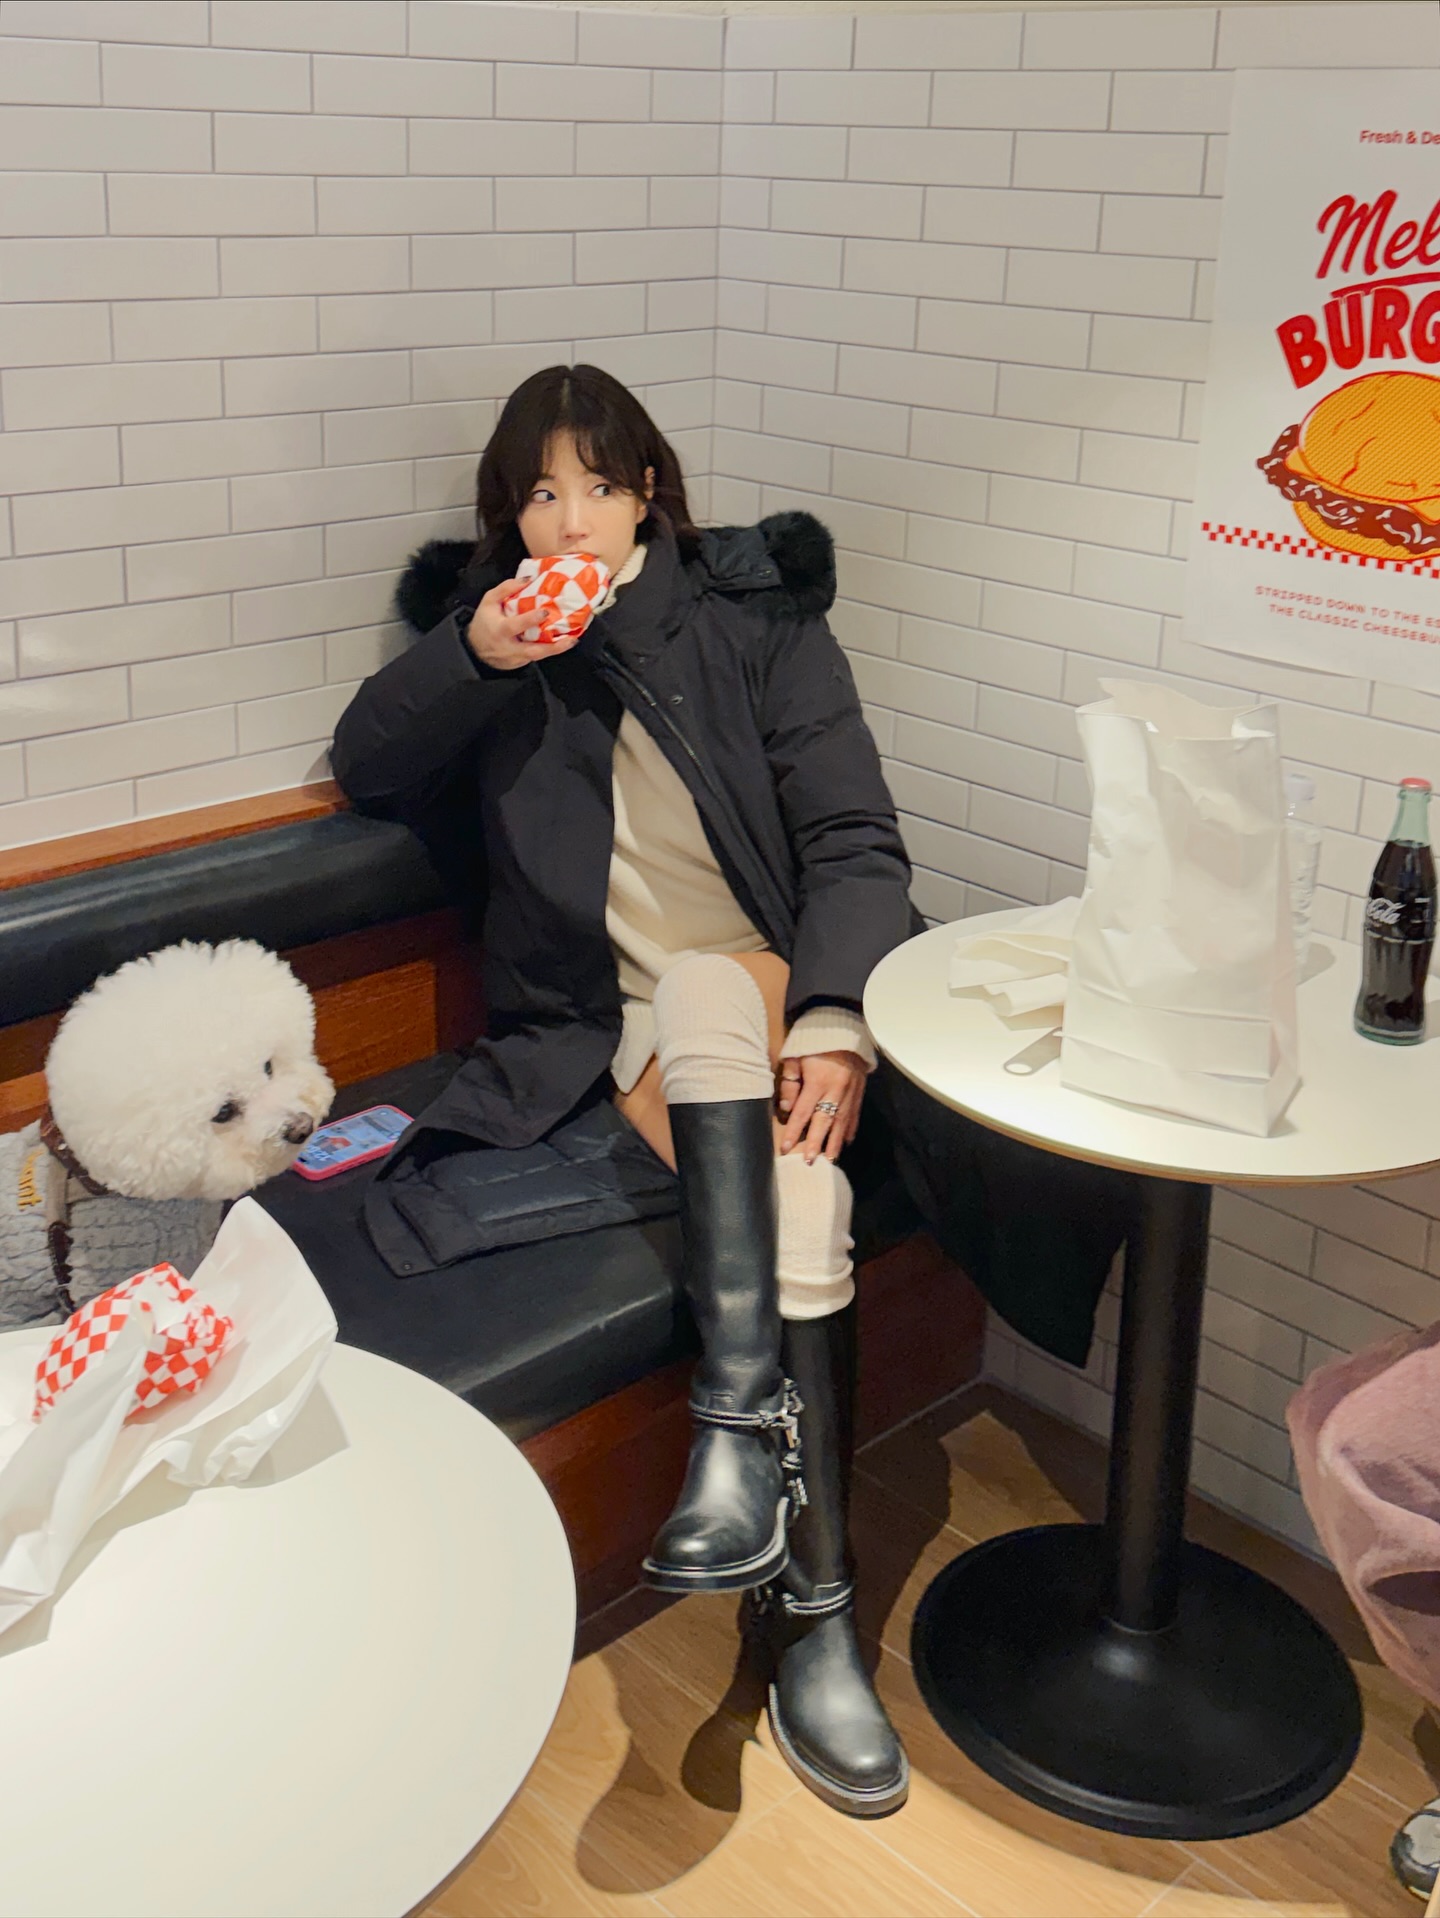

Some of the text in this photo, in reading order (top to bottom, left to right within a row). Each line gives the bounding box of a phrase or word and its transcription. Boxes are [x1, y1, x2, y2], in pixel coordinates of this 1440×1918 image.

[1360, 130, 1402, 144] Fresh
[1405, 131, 1417, 144] &
[1276, 286, 1440, 389] BURG
[1254, 585, 1323, 606] STRIPPED
[1326, 598, 1366, 614] DOWN
[1371, 607, 1390, 618] TO
[1393, 610, 1421, 625] THE
[1269, 603, 1440, 645] THE CLASSIC CHEESEBU
